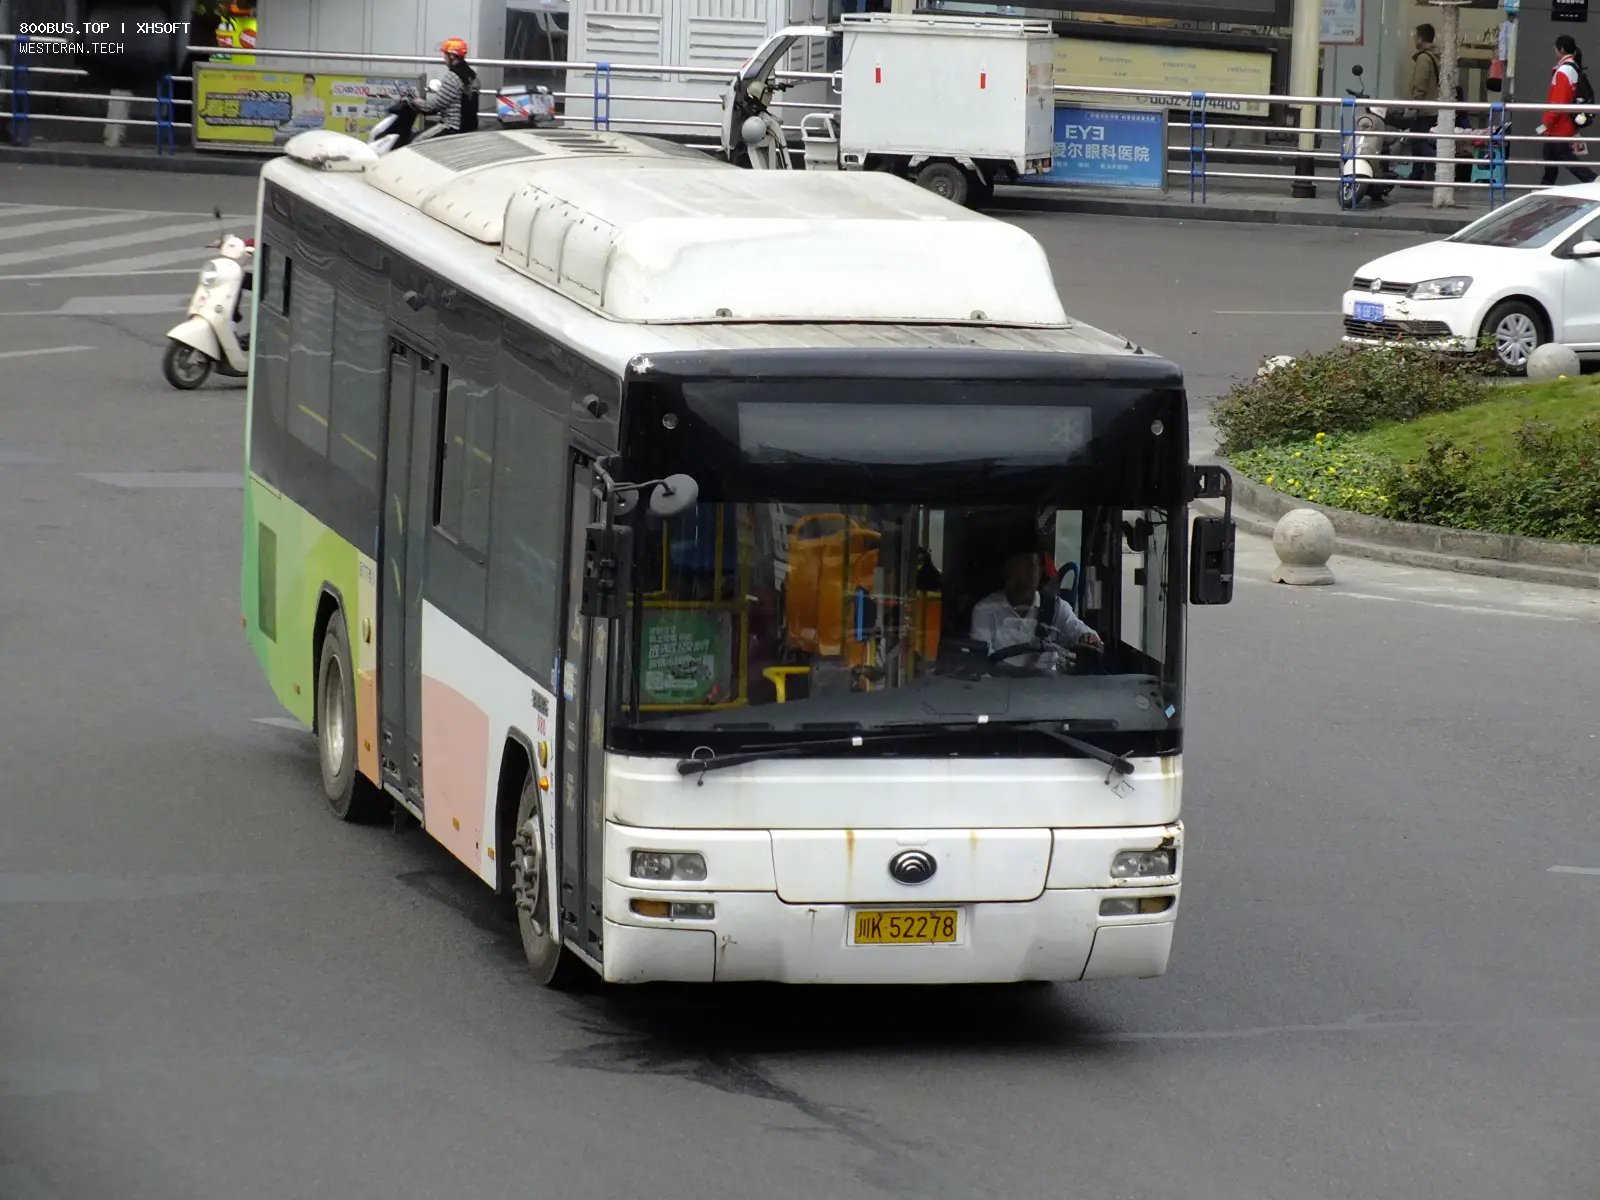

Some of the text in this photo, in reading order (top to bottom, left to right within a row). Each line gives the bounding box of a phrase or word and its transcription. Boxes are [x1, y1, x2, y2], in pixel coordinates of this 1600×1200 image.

[1053, 141, 1150, 162] 爱尔眼科医院
